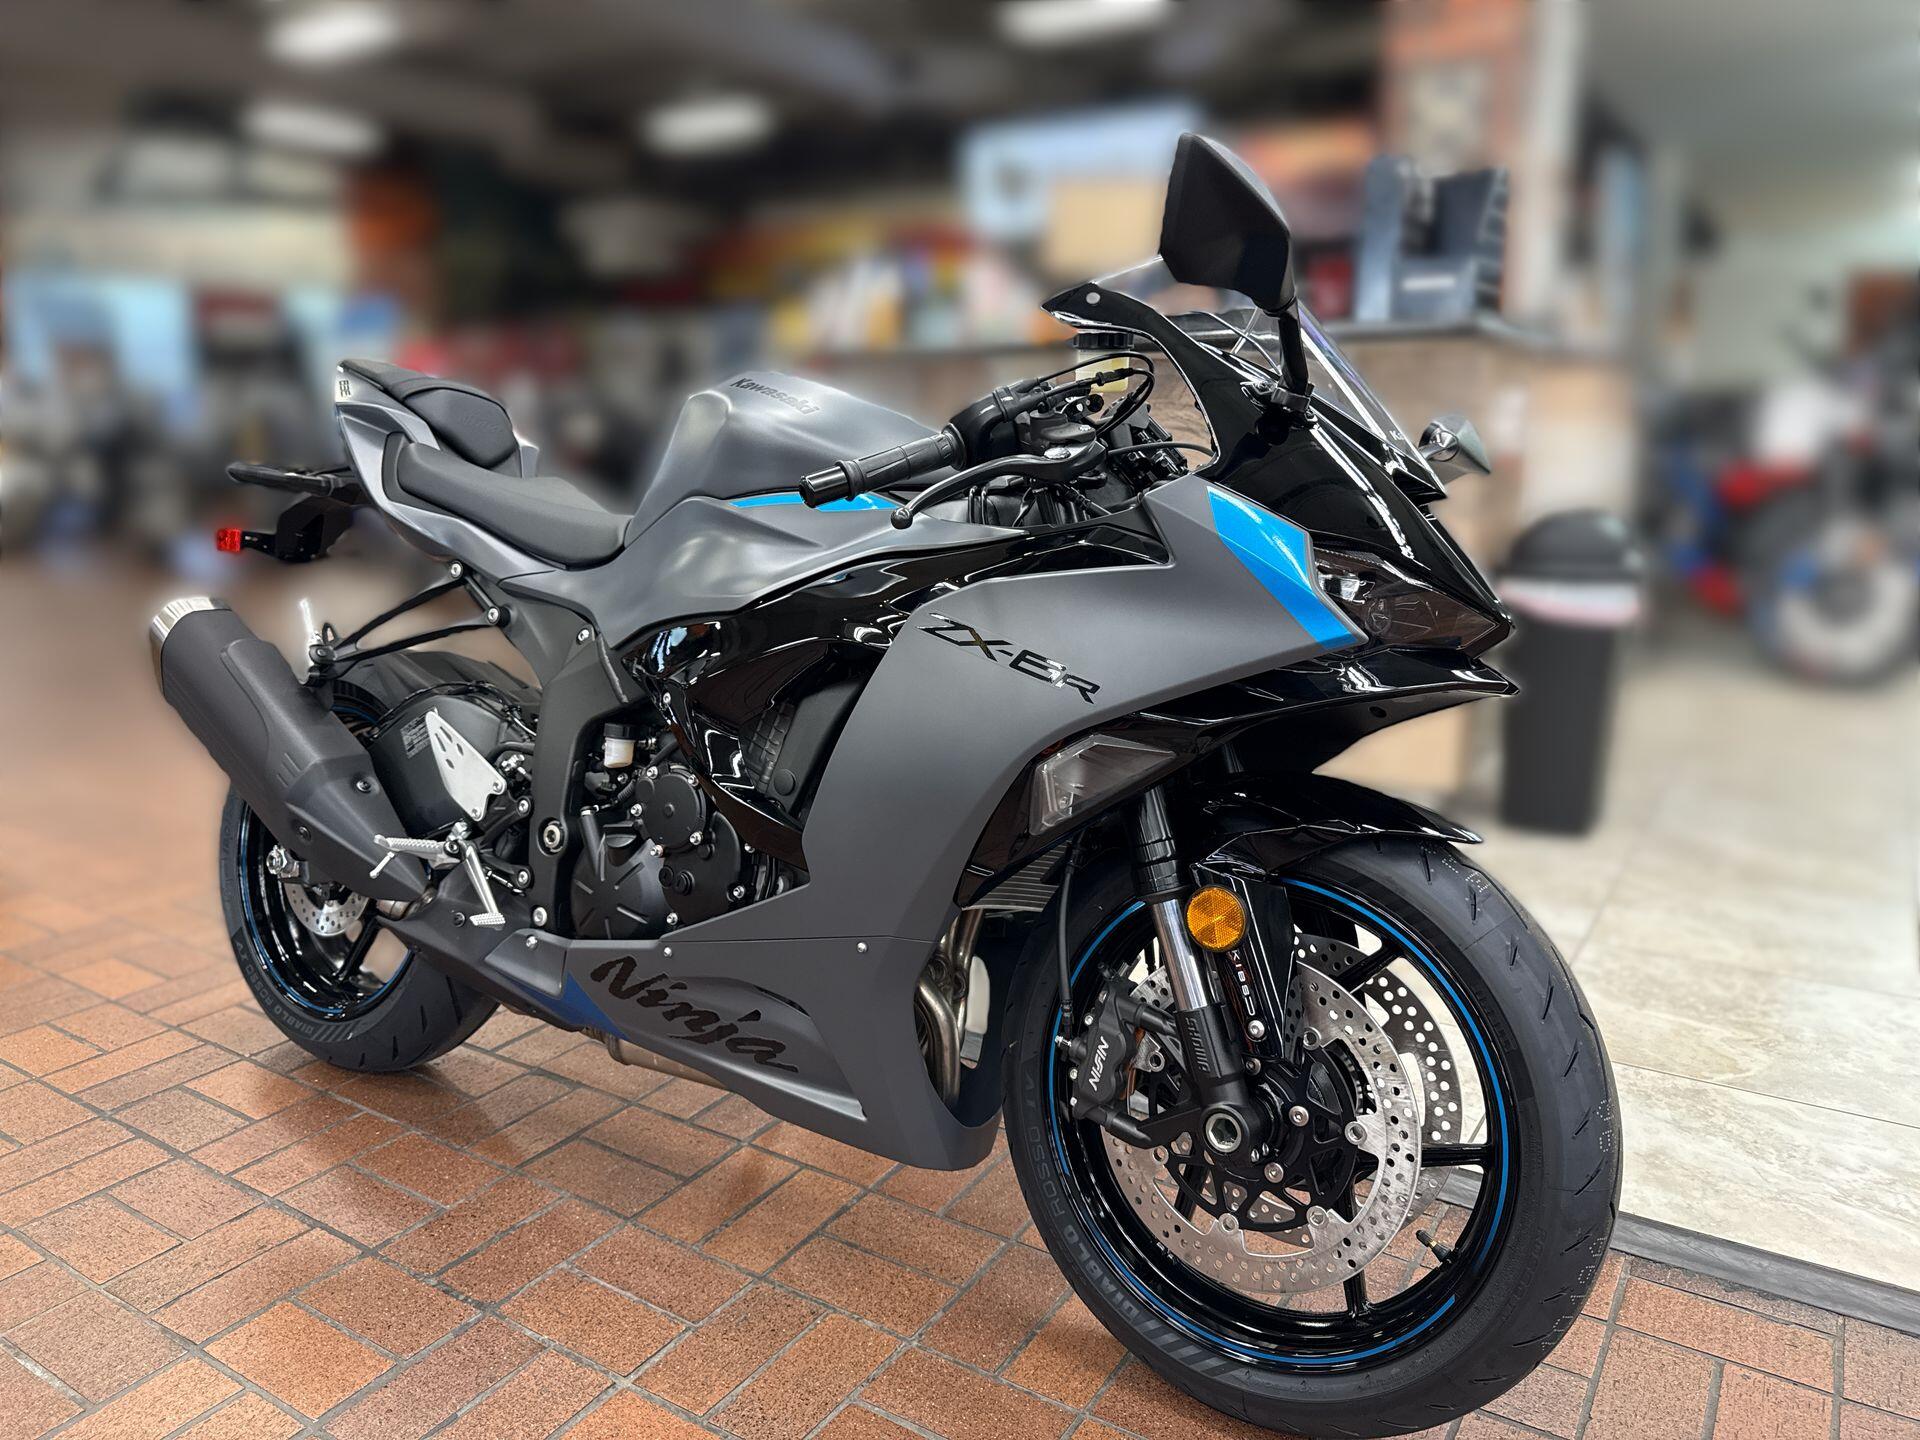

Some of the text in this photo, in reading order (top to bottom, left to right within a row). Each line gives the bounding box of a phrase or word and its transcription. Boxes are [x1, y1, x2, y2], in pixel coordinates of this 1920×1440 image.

[730, 378, 820, 414] Kawasaki
[915, 612, 1101, 704] ZX-6R
[590, 955, 799, 1074] Ninja
[1088, 1035, 1109, 1092] NISSIN
[1027, 1126, 1065, 1217] ROSSO
[1063, 1223, 1141, 1321] DIABLO
